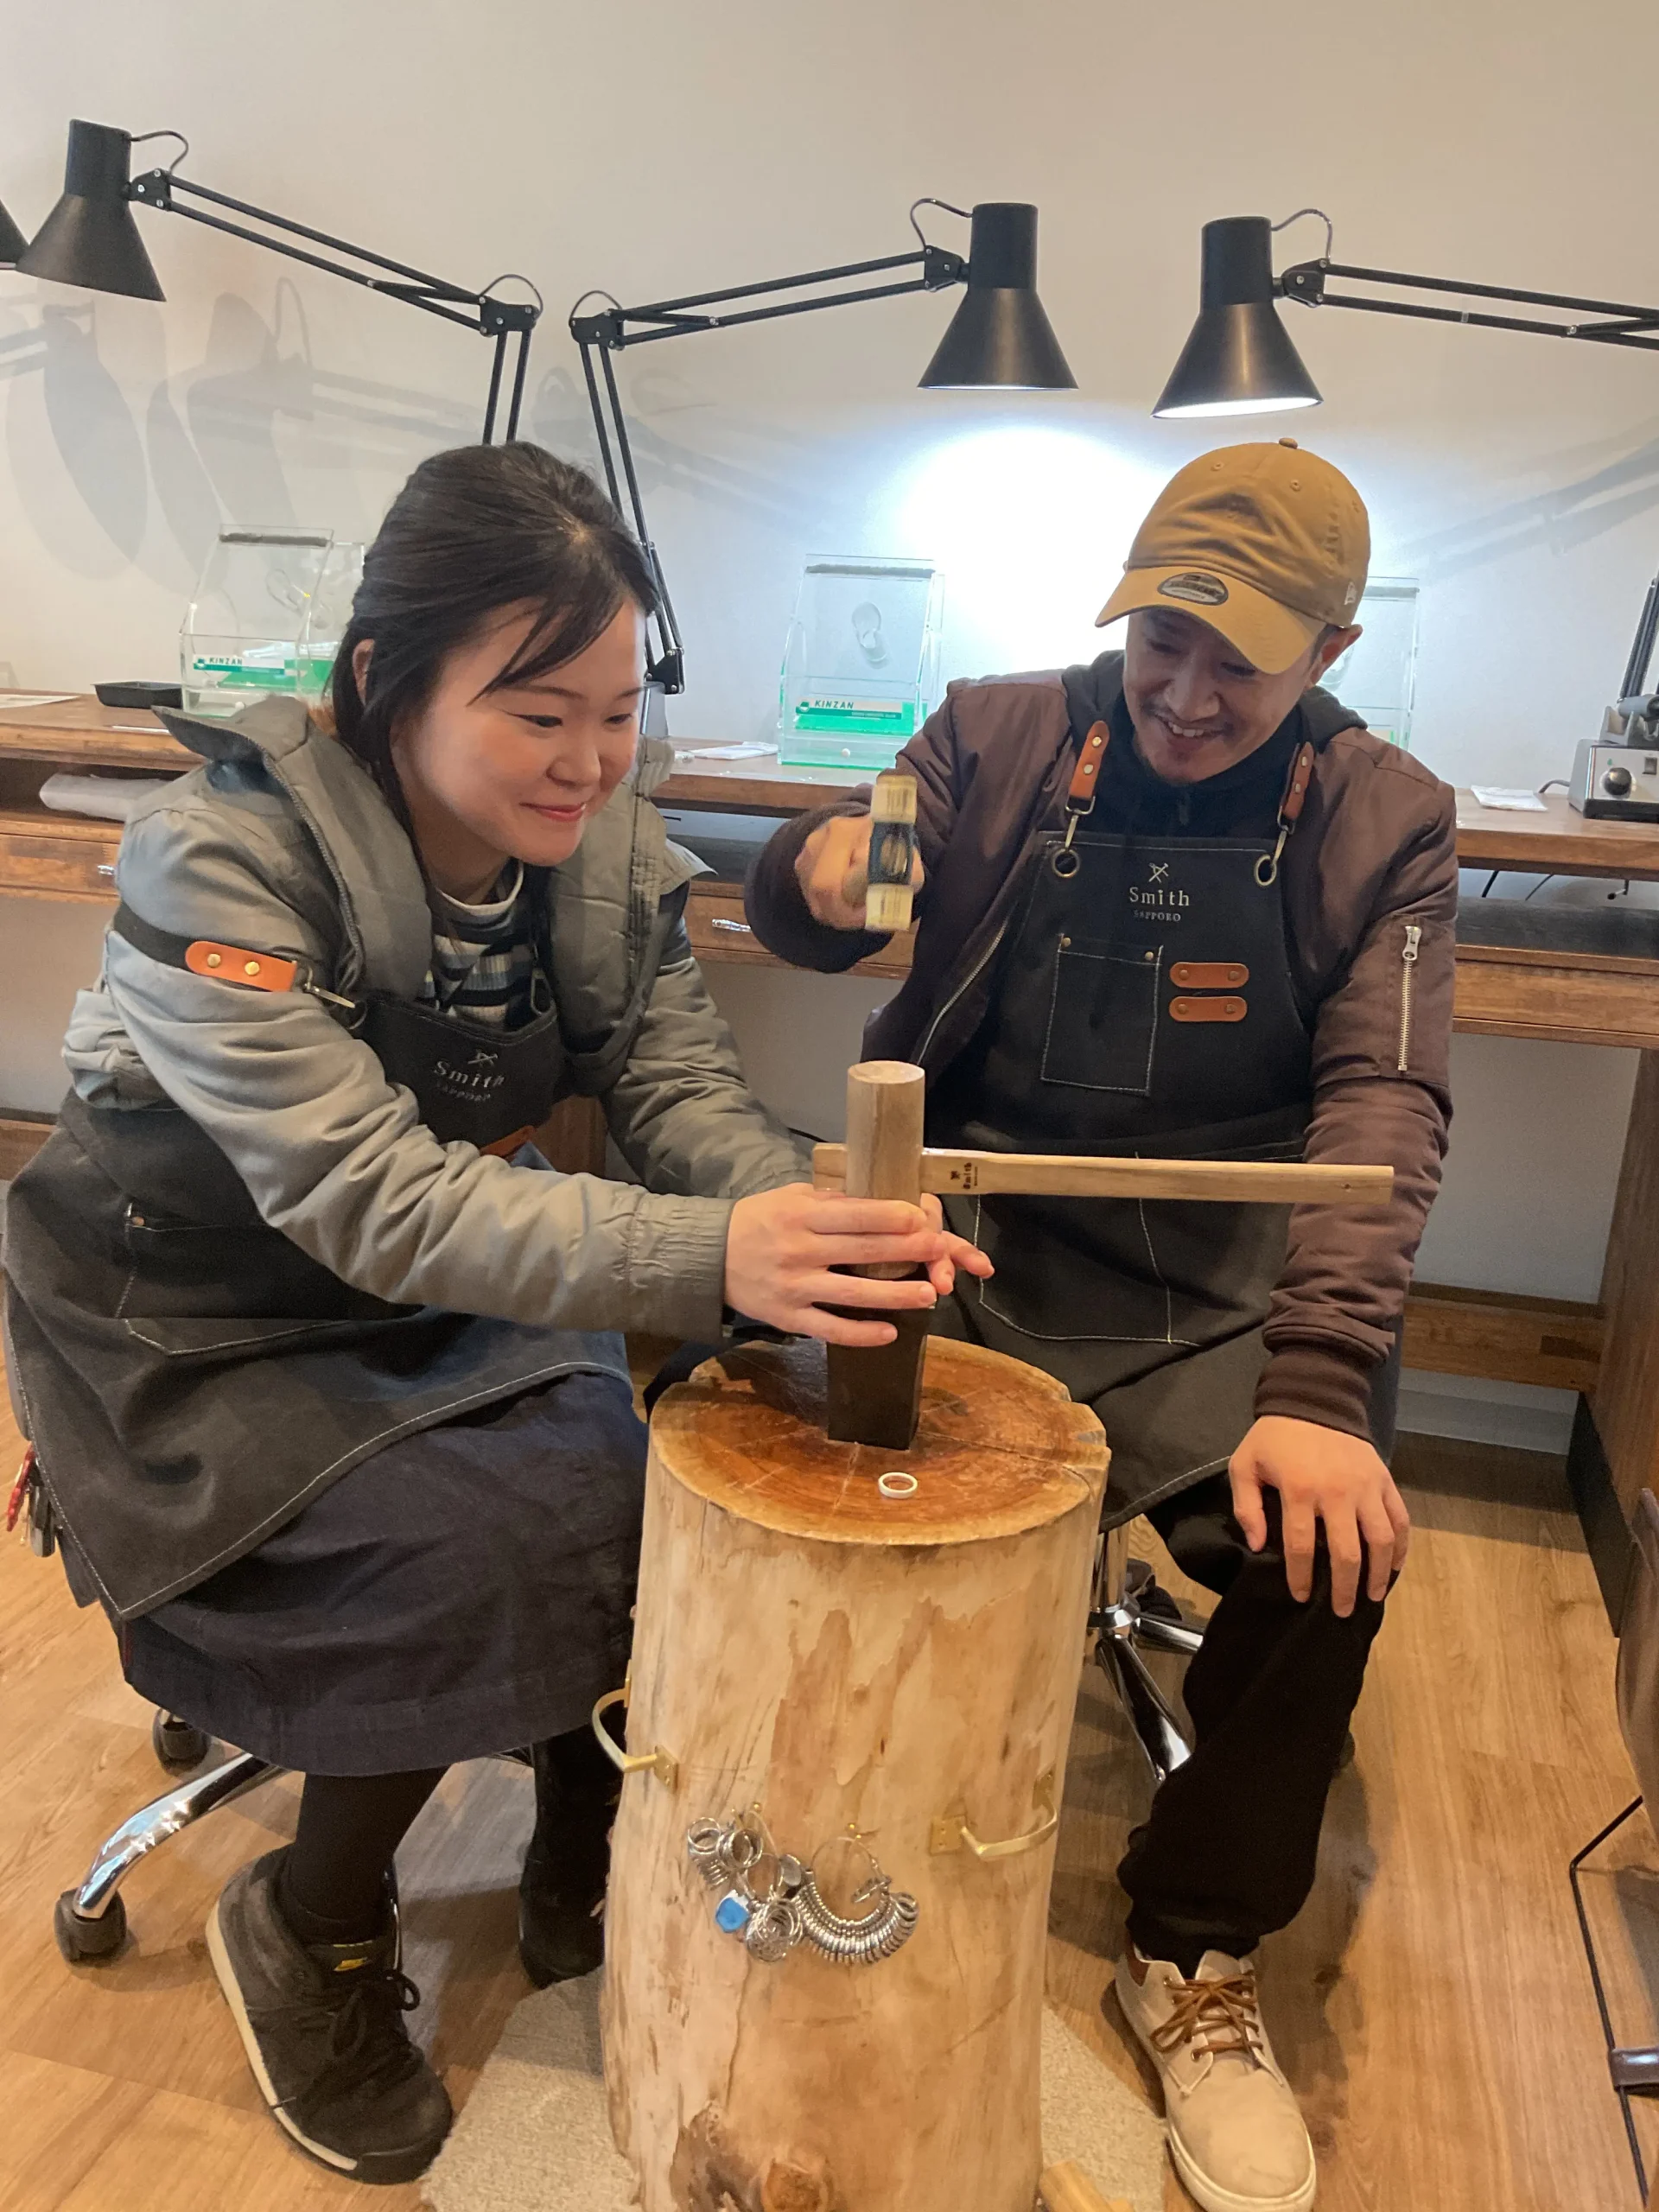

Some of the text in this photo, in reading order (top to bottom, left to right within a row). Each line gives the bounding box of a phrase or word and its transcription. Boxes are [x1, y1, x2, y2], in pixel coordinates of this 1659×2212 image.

[209, 657, 243, 665] KINZAN
[815, 700, 855, 709] KINZAN
[1129, 887, 1190, 906] Smith
[434, 1060, 505, 1088] Smith
